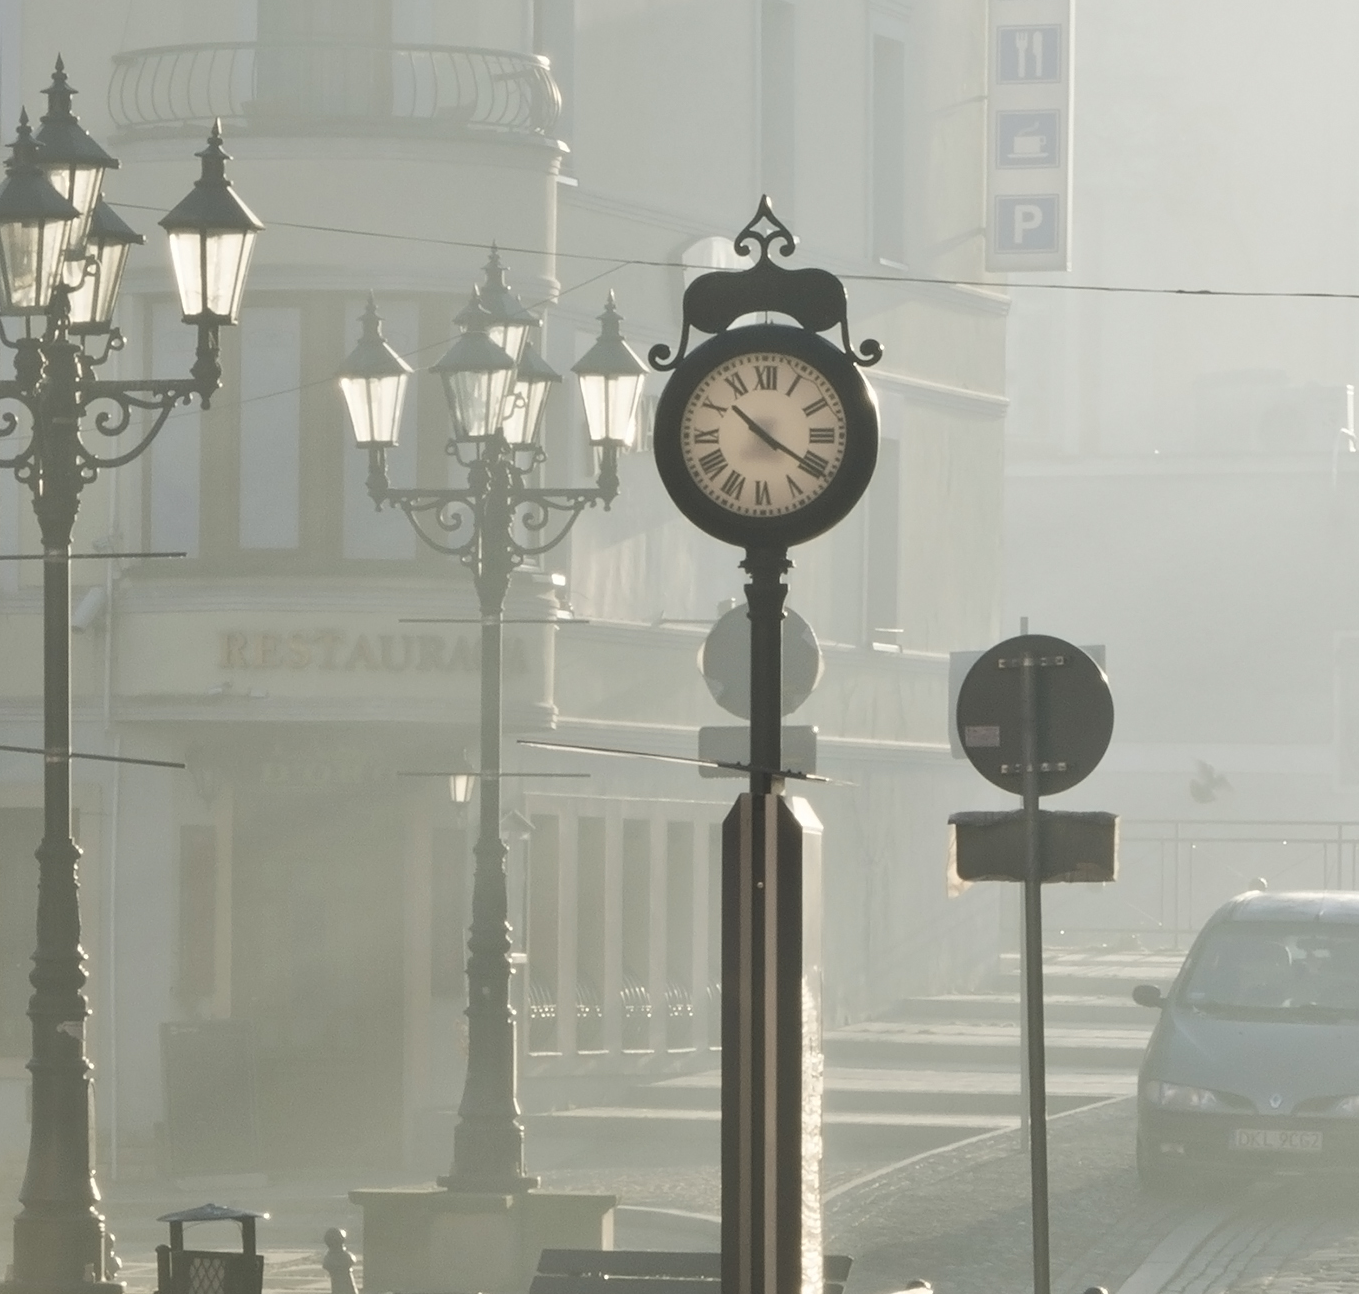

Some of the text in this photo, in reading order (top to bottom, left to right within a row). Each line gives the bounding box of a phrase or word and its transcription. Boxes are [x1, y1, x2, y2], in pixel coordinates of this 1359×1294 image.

[1014, 204, 1043, 244] P
[724, 372, 749, 400] XI
[753, 365, 778, 391] XII
[785, 375, 803, 397] I
[702, 397, 728, 418] X
[802, 396, 828, 417] II
[694, 427, 720, 444] IX
[809, 427, 835, 444] III
[698, 448, 729, 482] VIII
[720, 470, 746, 501] VII
[755, 480, 772, 506] VI
[786, 474, 804, 498] V
[1239, 1130, 1273, 1147] DKL
